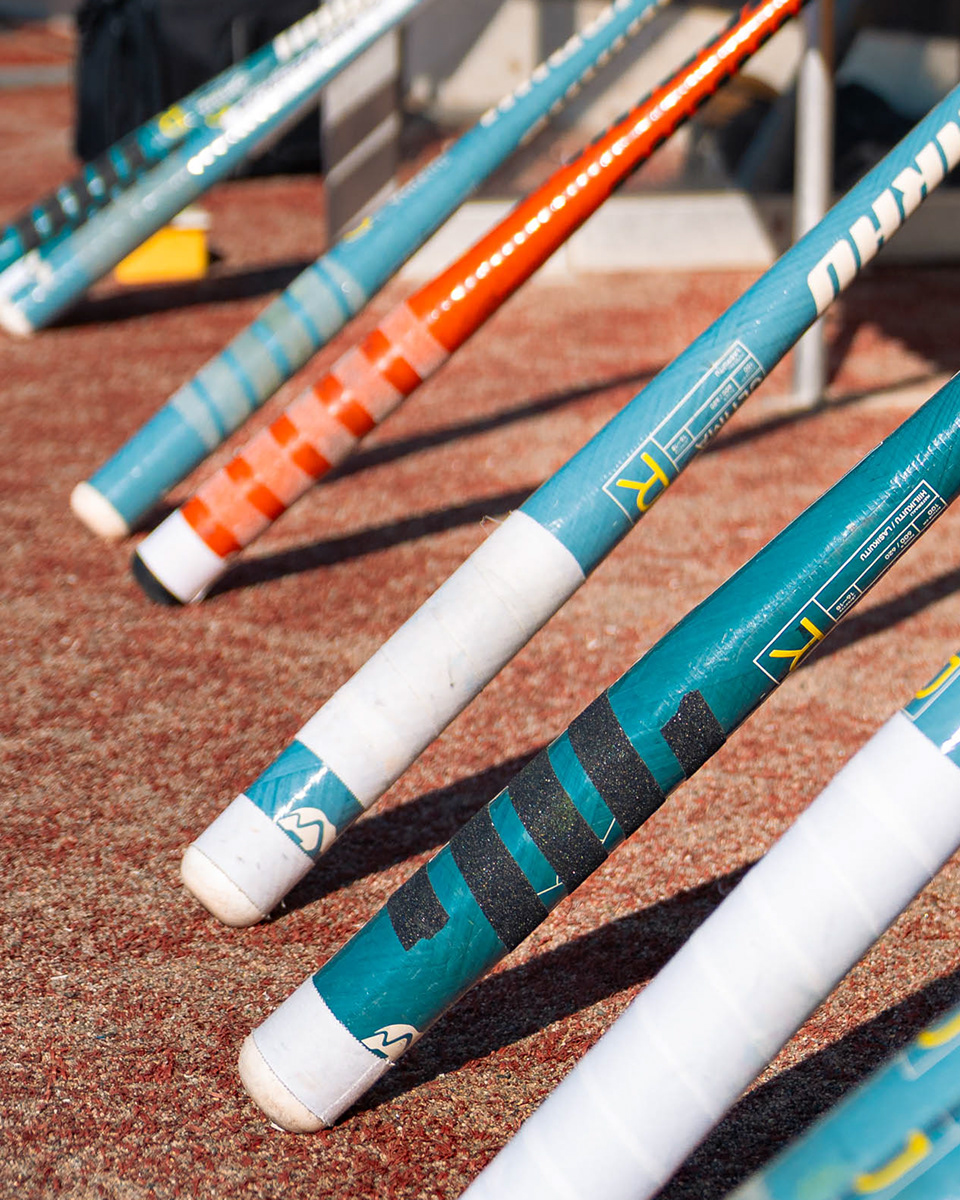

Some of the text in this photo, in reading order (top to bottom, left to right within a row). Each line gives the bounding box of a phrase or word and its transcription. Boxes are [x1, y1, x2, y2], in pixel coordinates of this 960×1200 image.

[616, 452, 670, 512] R
[894, 489, 928, 525] HIILIKUITU
[927, 503, 940, 516] 100
[860, 524, 894, 562] LASIKUITU
